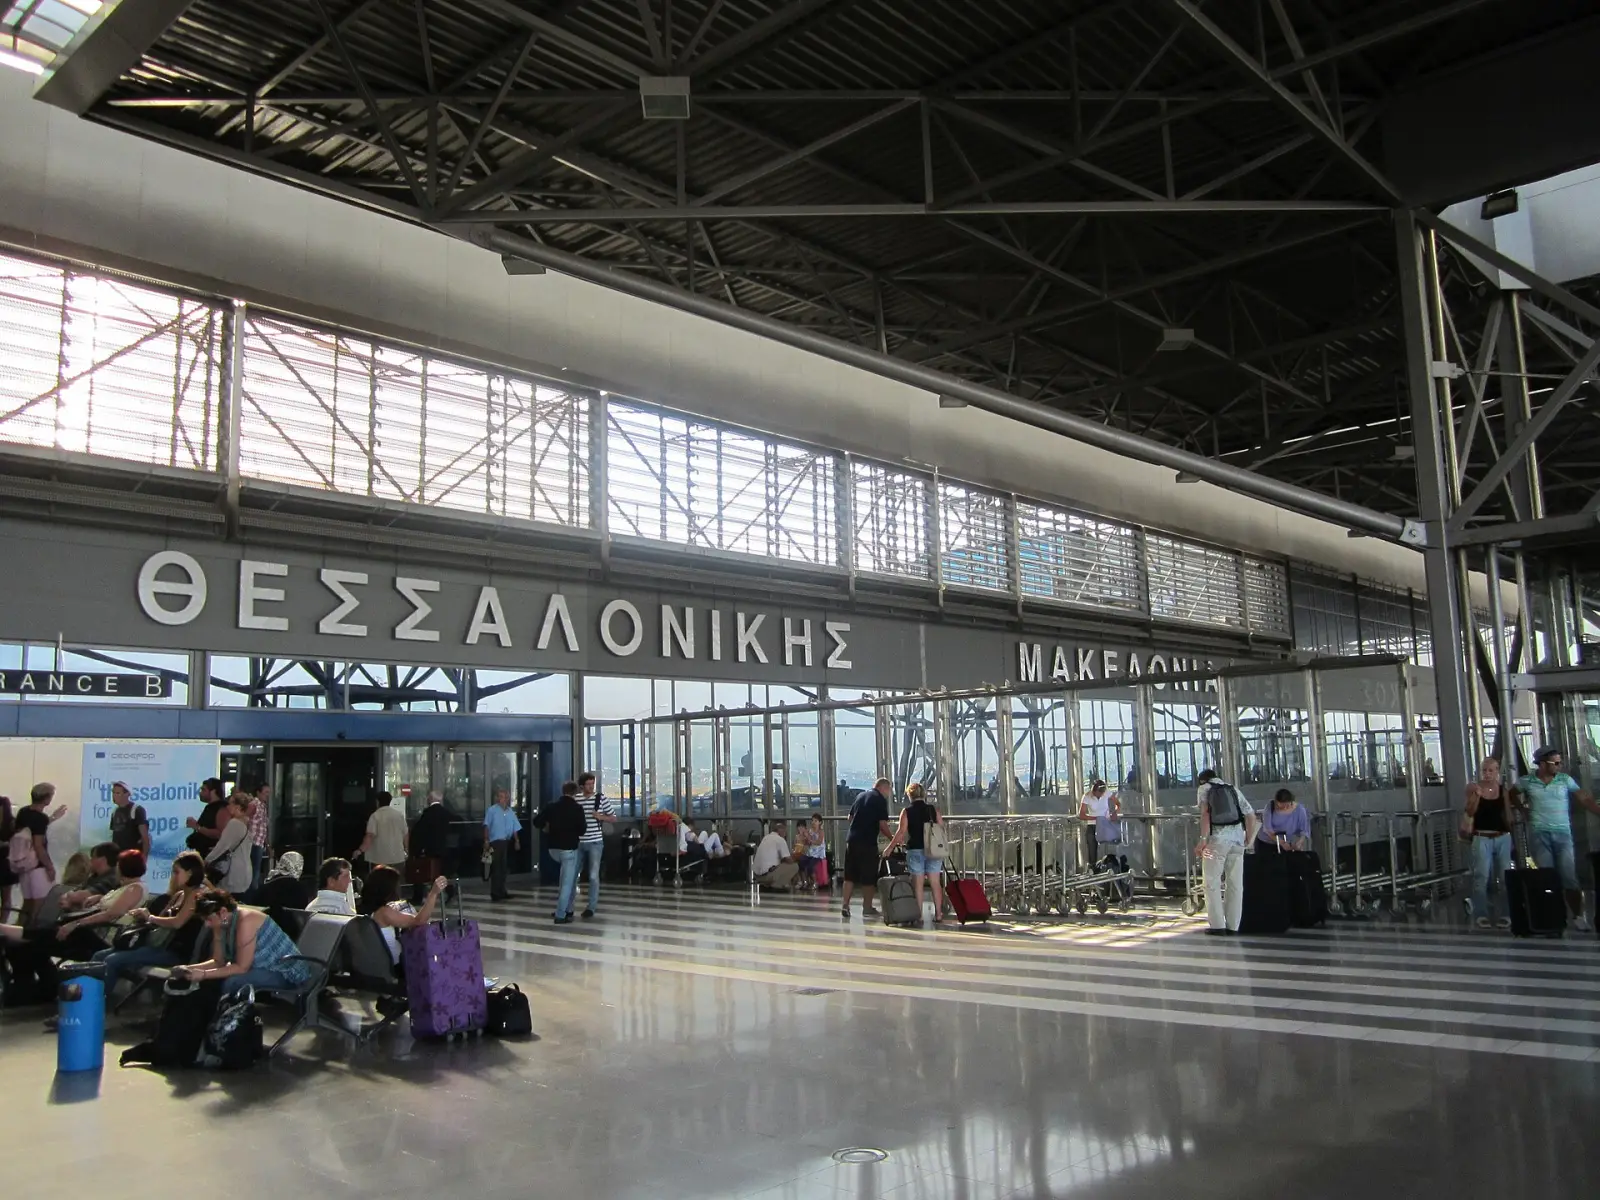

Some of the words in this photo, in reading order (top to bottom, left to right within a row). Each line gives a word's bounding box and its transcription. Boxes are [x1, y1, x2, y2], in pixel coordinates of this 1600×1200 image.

[137, 550, 853, 670] ΘΕΣΣΑΛΟΝΙΚΗΣ
[145, 675, 162, 697] B
[89, 774, 101, 790] in
[93, 803, 112, 819] for
